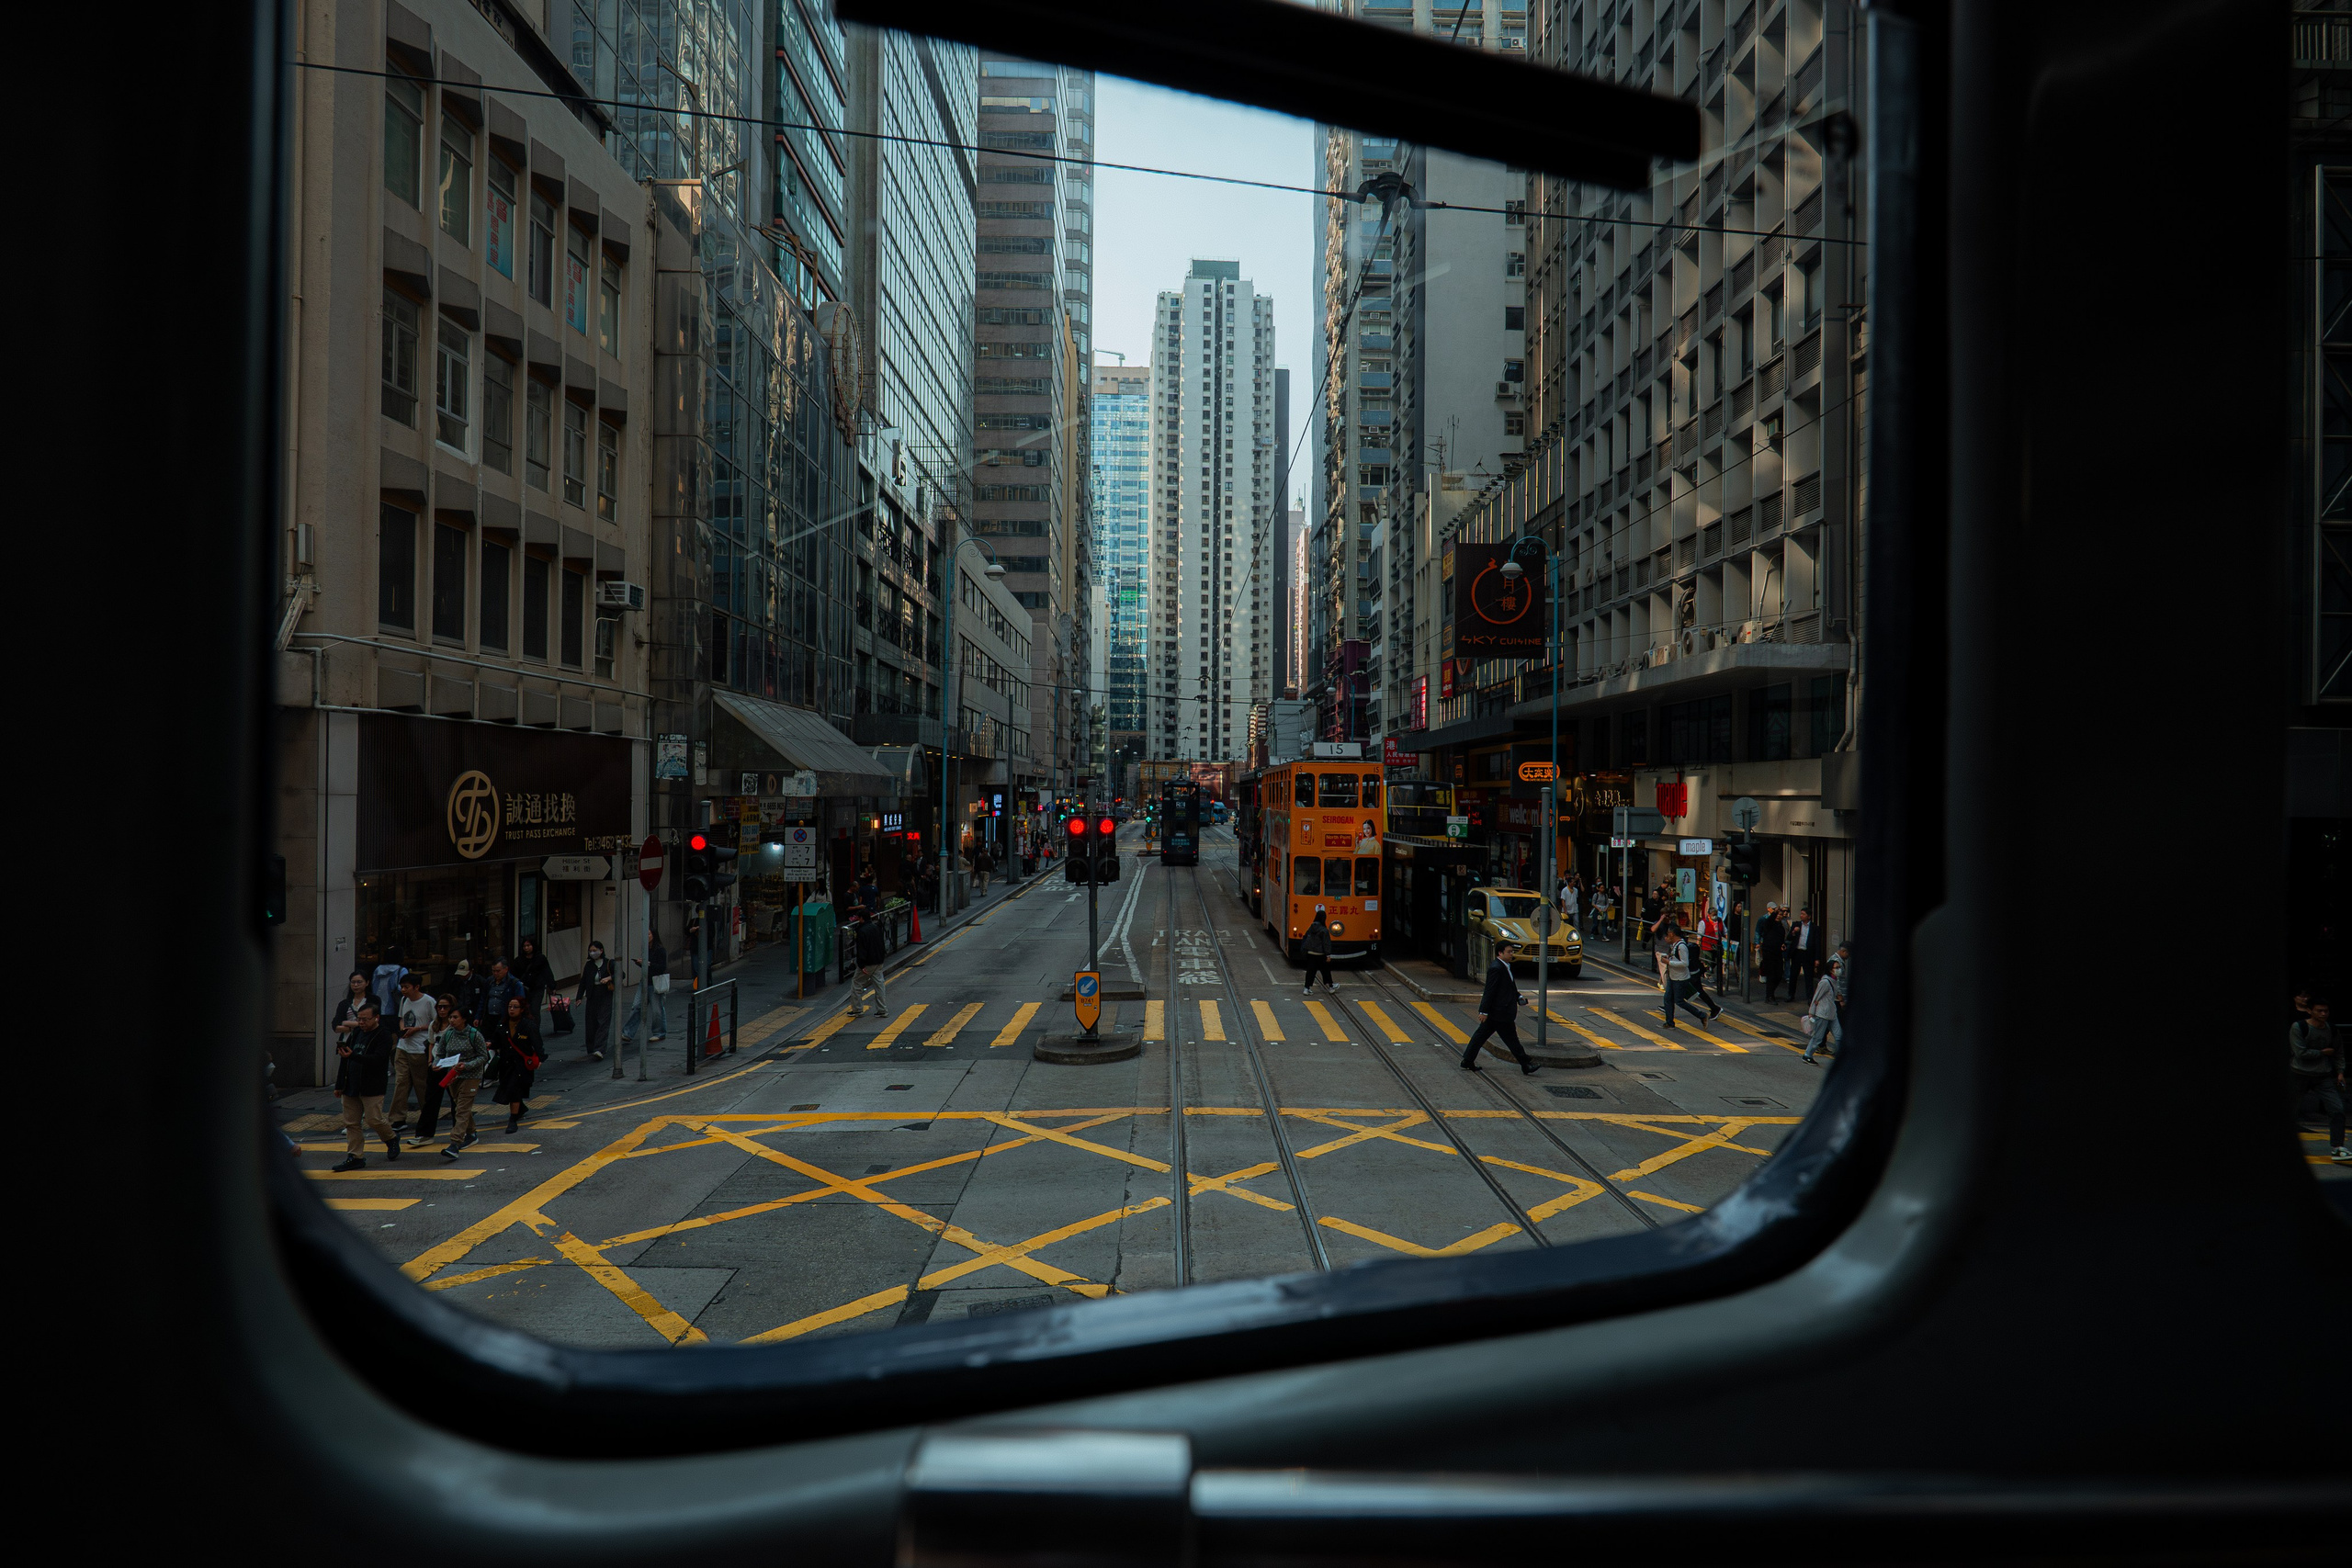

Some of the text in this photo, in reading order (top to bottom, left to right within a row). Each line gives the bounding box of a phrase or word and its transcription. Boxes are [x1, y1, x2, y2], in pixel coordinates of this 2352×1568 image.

[1501, 566, 1516, 612] 月樓
[1460, 635, 1497, 645] SKY
[1499, 637, 1543, 646] CUISINE
[1329, 743, 1344, 755] 15
[1657, 771, 1688, 825] maple
[504, 792, 576, 826] 誠通找換
[1509, 803, 1540, 825] wellcom
[1322, 815, 1354, 824] SEIROGAN
[504, 827, 576, 840] TRUST PASS EXCHANGE
[583, 835, 615, 852] Tel:3462
[1685, 840, 1706, 854] maple
[804, 846, 810, 854] 7
[804, 857, 810, 865] 7
[1329, 906, 1359, 915] 正露丸
[1151, 937, 1237, 946] LANE
[1371, 942, 1377, 951] 15
